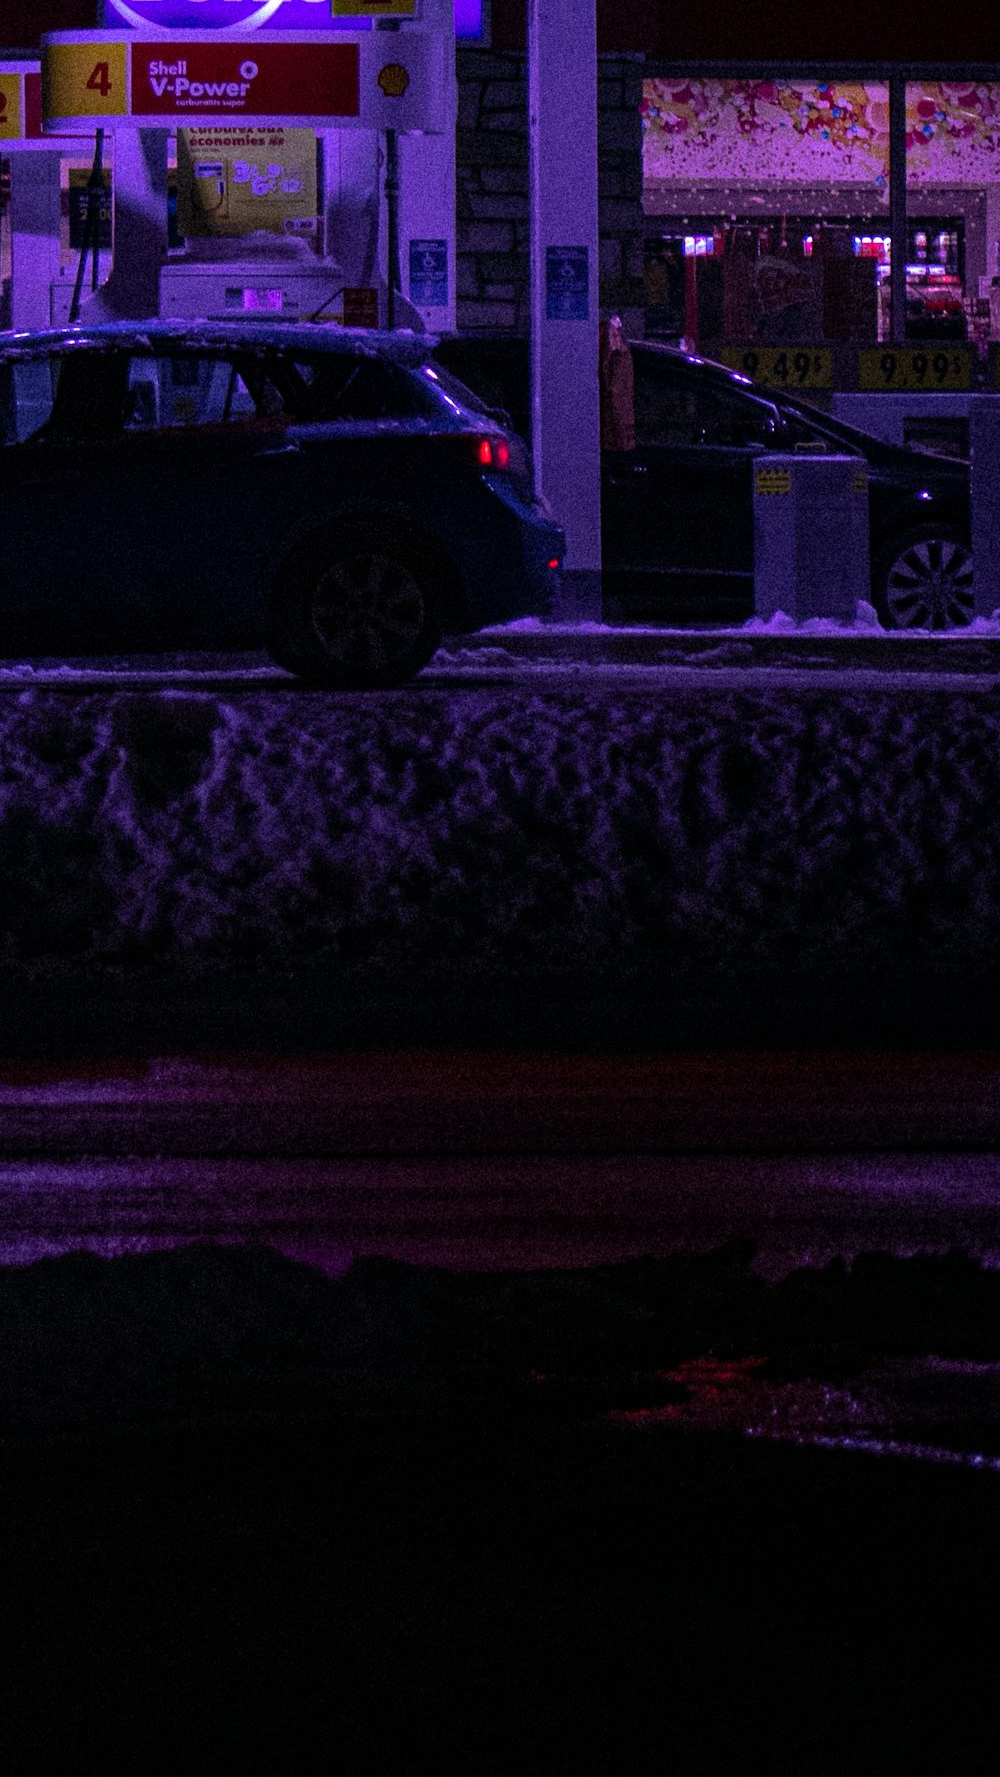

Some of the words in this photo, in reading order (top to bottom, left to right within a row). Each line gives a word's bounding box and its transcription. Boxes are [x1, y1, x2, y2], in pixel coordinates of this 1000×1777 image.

[86, 61, 112, 97] 4
[149, 60, 188, 77] Shell
[149, 76, 251, 98] V-Power
